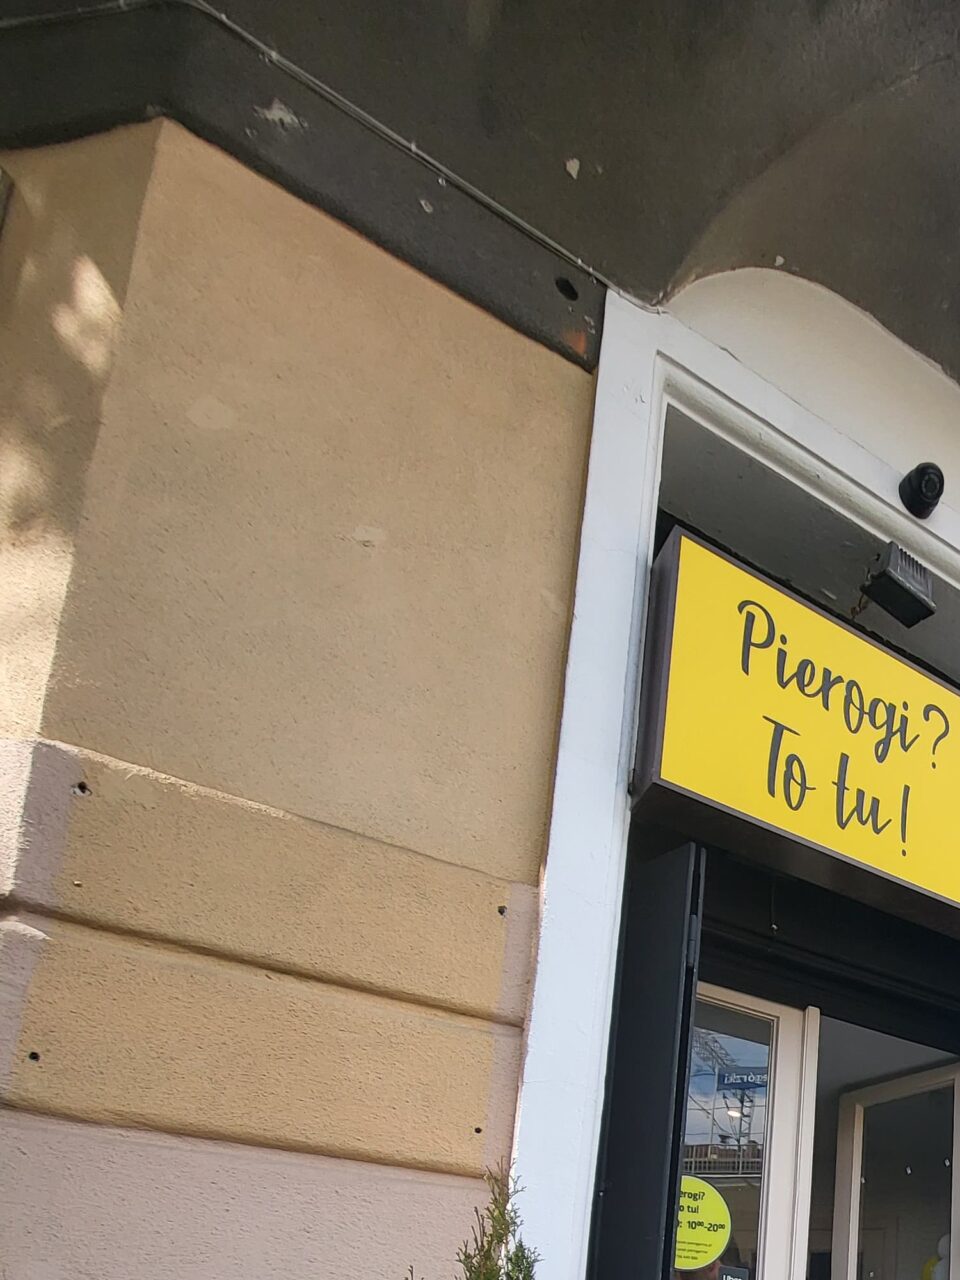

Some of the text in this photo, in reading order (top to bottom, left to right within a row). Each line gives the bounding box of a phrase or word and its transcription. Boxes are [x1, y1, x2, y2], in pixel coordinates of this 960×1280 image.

[737, 600, 950, 769] Pierogi?
[762, 715, 910, 857] To tu!
[680, 1190, 705, 1201] erogi?
